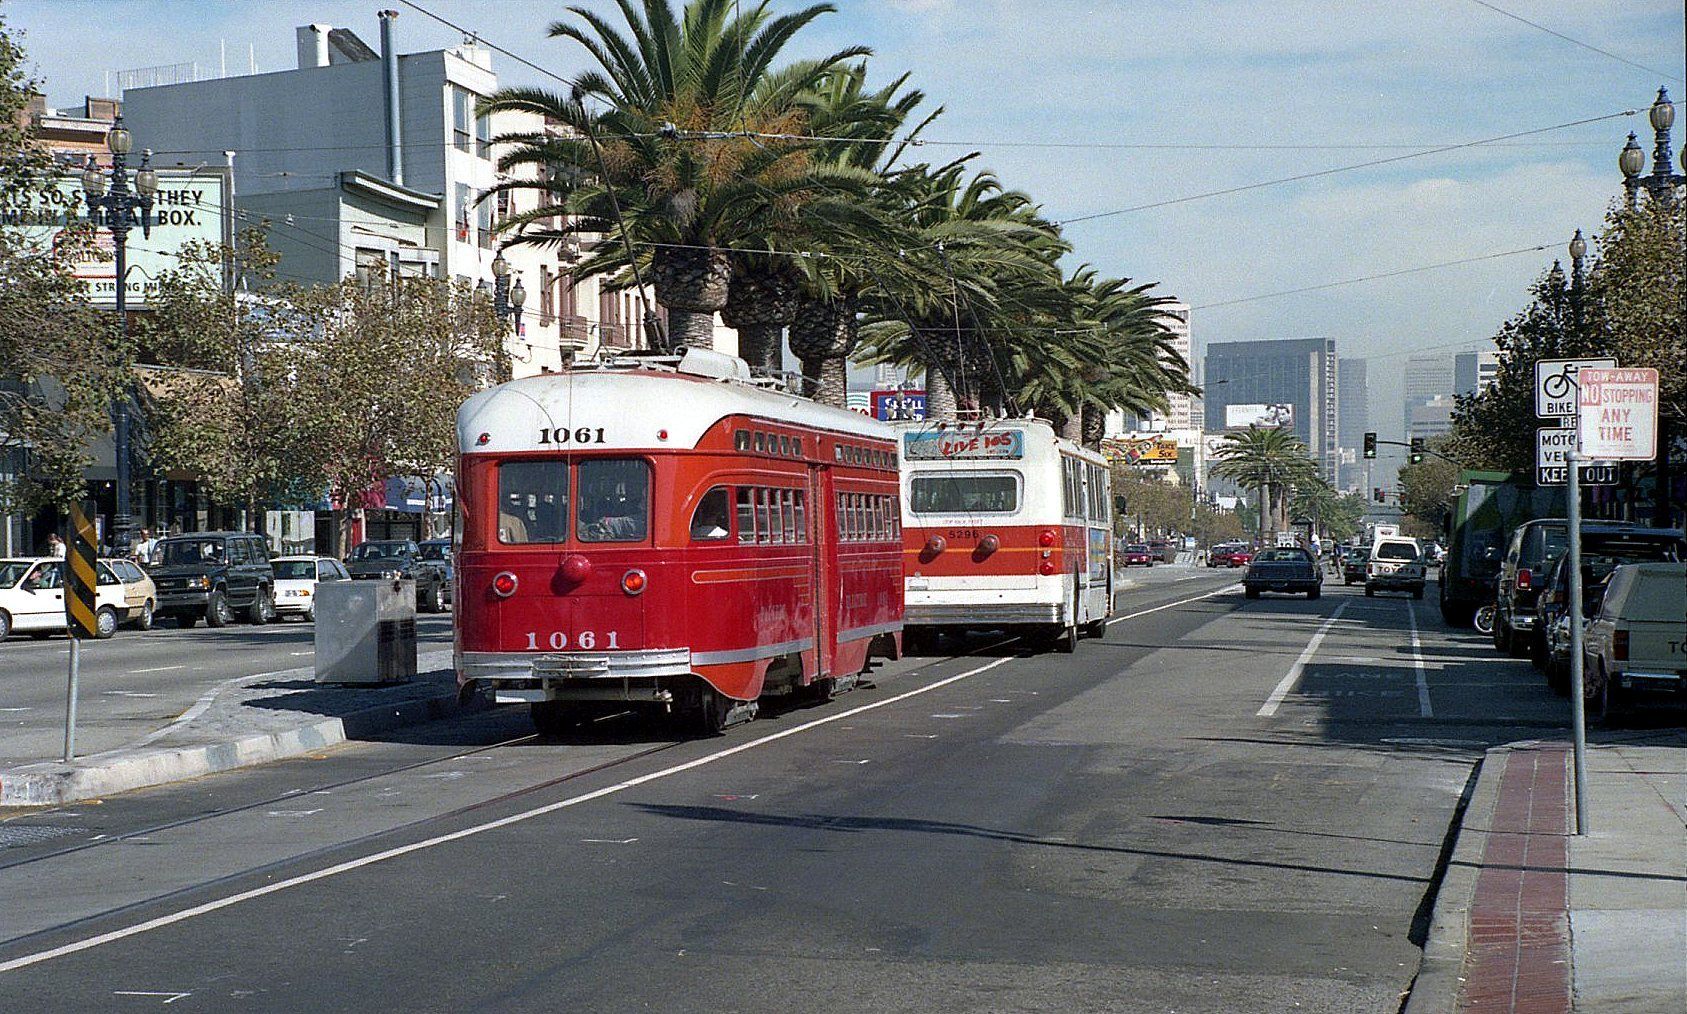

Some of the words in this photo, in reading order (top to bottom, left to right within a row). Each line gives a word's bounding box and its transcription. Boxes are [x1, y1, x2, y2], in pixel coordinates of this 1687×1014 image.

[40, 189, 63, 204] SO
[157, 189, 203, 206] THEY
[158, 209, 202, 226] BOX.
[95, 282, 140, 292] STRNG
[1587, 371, 1648, 382] TOW-AWAY
[1581, 384, 1600, 403] NO
[1603, 388, 1653, 403] STOPPING
[1547, 402, 1573, 413] BIKE
[1601, 408, 1630, 423] ANY
[538, 427, 606, 444] 1061
[1599, 427, 1633, 441] TIME
[942, 438, 979, 456] LIVE
[1541, 468, 1568, 482] KEE
[1586, 468, 1614, 482] OUT
[1378, 565, 1416, 575] TOYOTA
[525, 630, 620, 650] 1061
